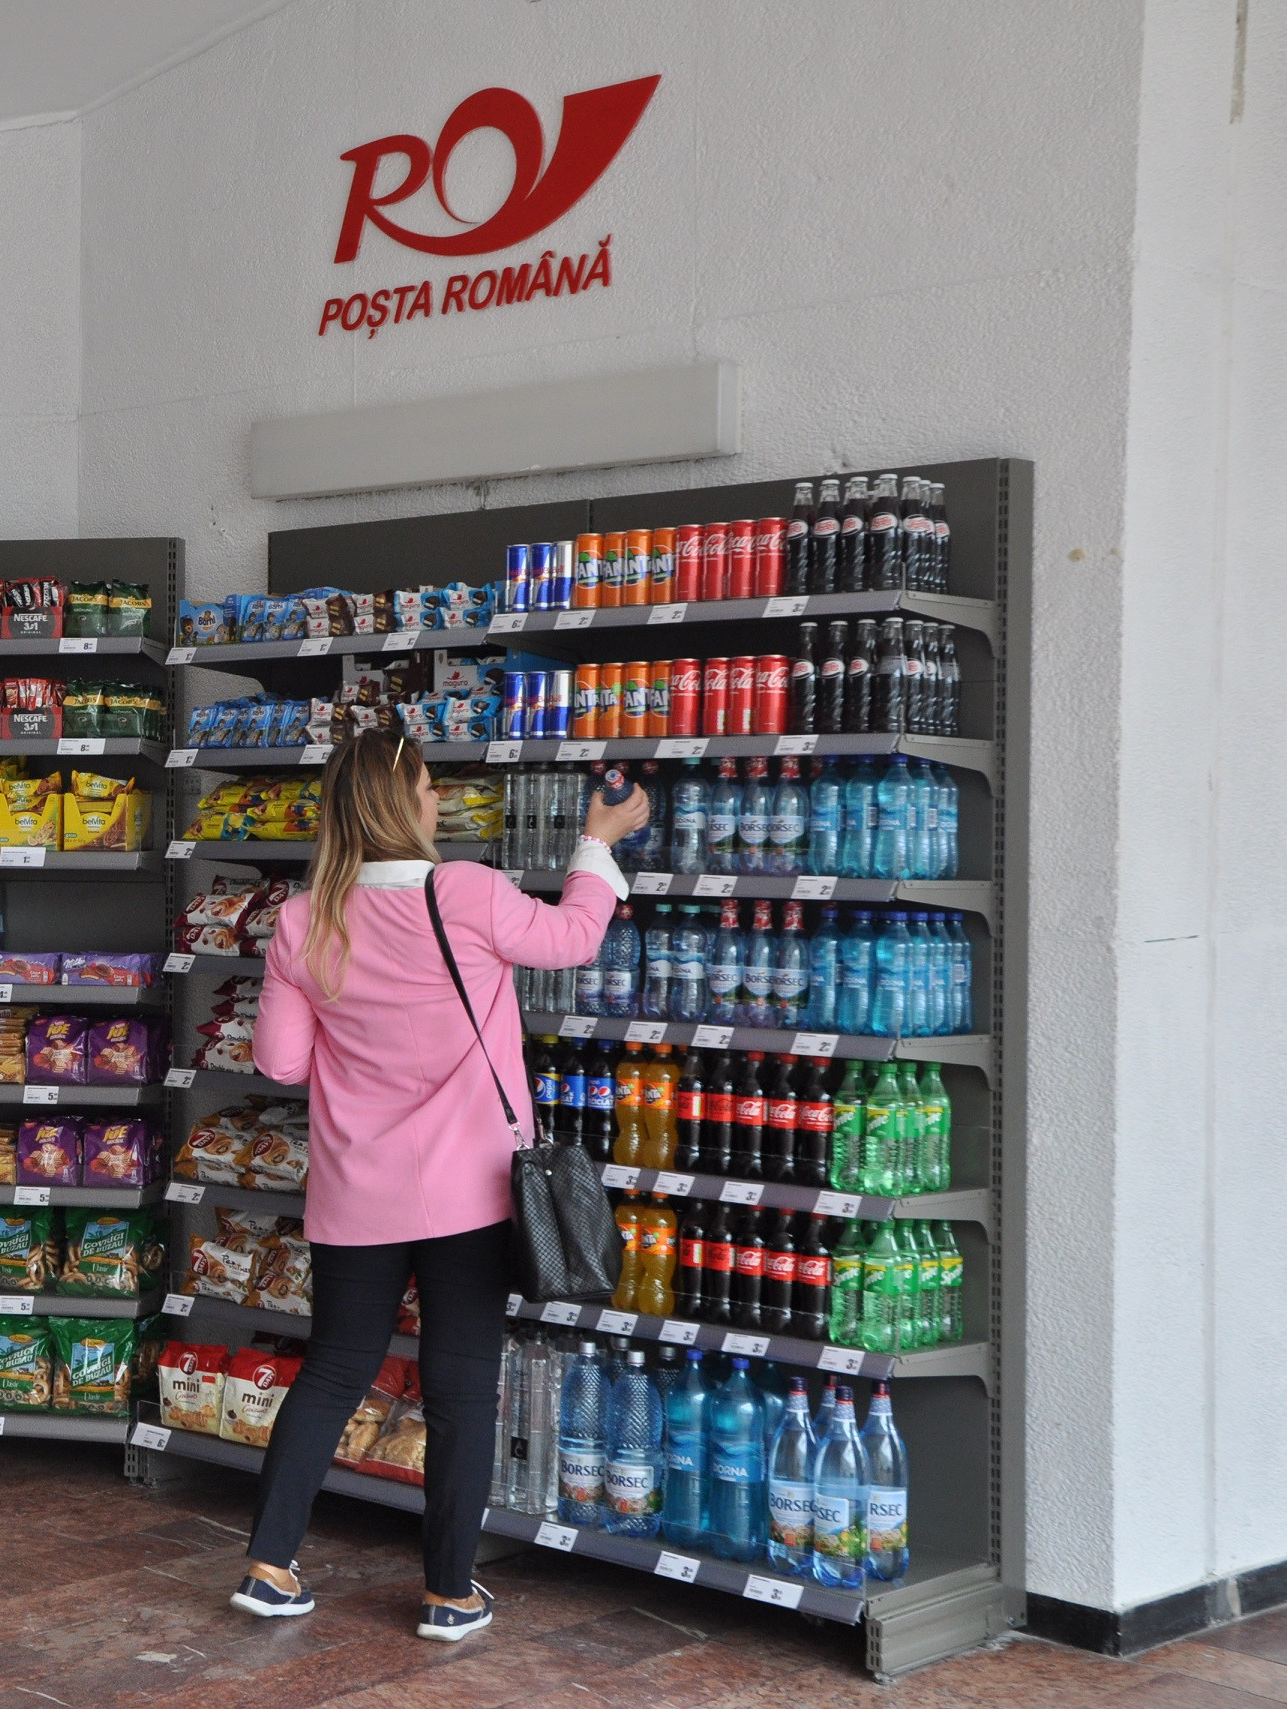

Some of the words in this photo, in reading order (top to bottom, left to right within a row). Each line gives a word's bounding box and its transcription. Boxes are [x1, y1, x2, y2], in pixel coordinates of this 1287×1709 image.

[318, 281, 434, 339] POȘTA
[441, 233, 613, 315] ROMÂNĂ
[14, 816, 38, 826] belVita
[82, 816, 106, 826] belVita
[172, 1377, 200, 1393] mini
[257, 1367, 269, 1388] 7
[242, 1392, 274, 1408] mini
[561, 1460, 604, 1477] BORSEC
